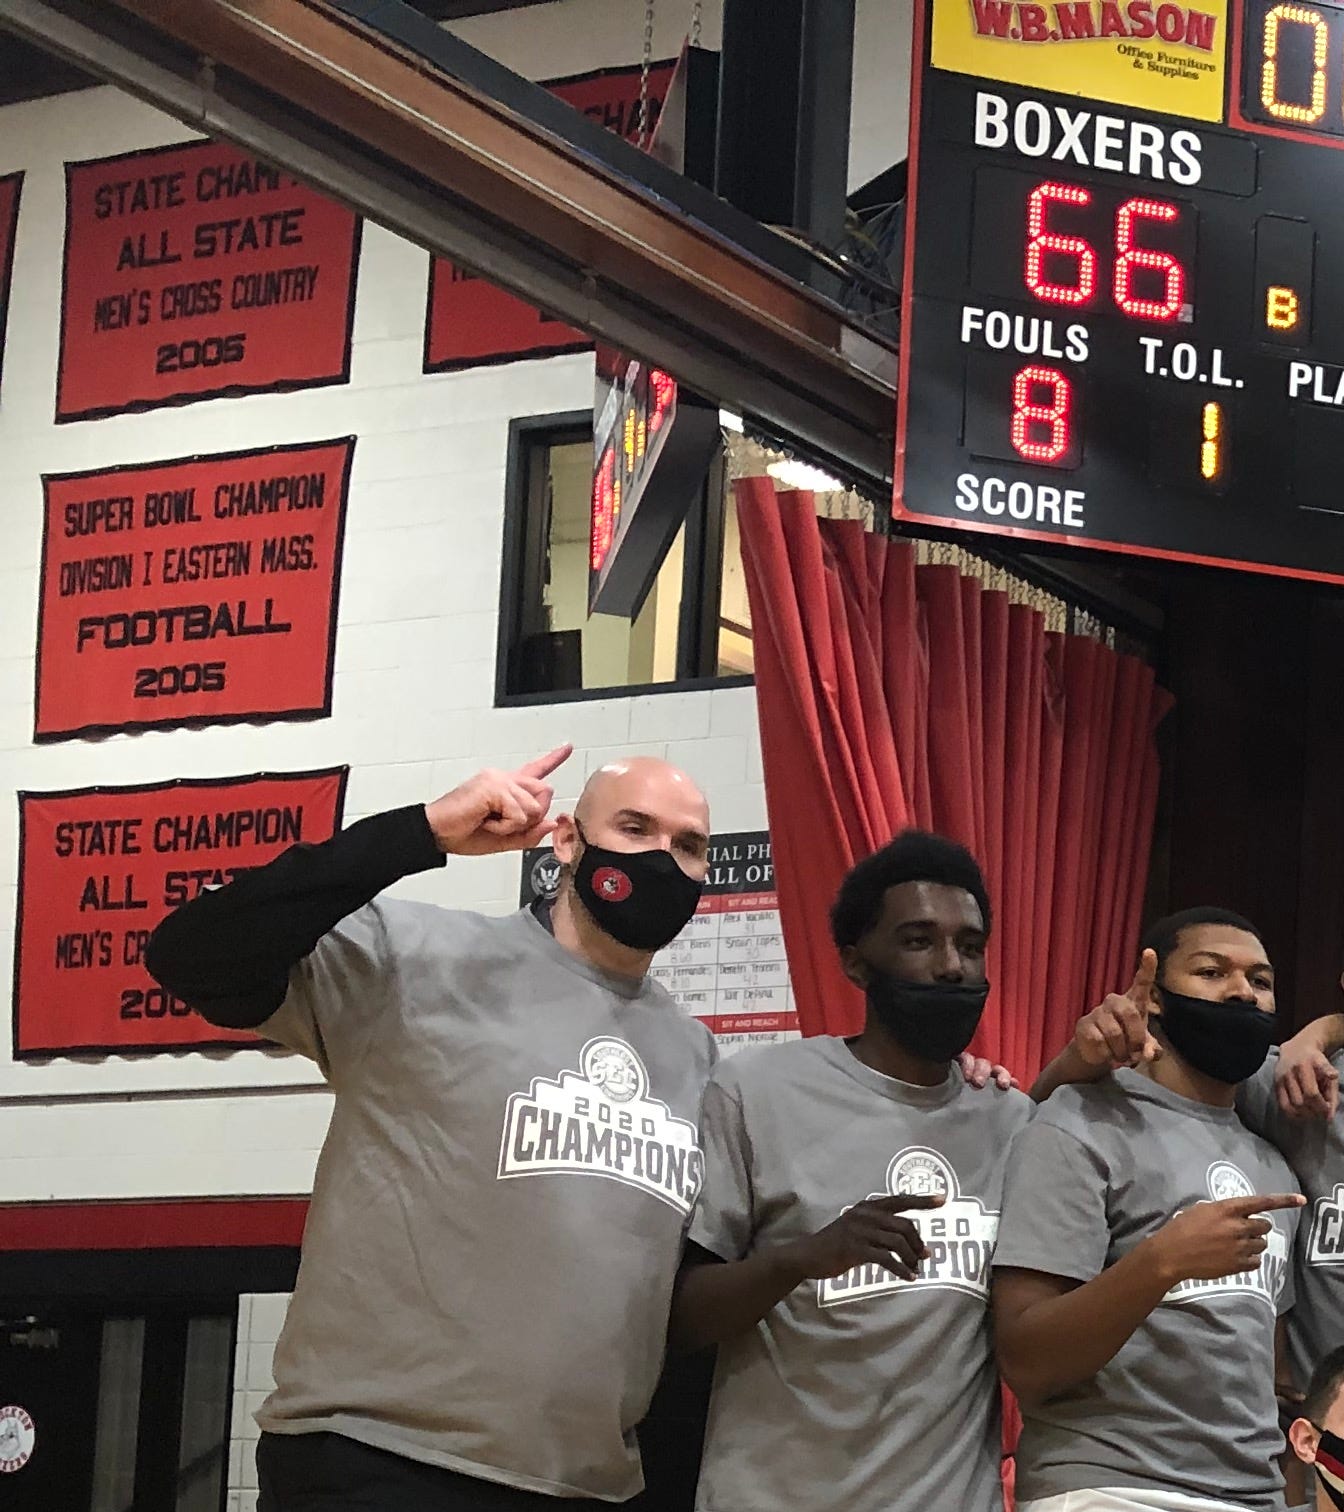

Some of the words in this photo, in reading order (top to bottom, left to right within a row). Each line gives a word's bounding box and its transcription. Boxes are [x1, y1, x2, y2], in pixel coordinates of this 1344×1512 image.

[972, 0, 1216, 51] W.B.MASON
[1117, 43, 1154, 61] Office
[1157, 51, 1216, 73] Furniture
[1133, 59, 1143, 70] &
[1147, 62, 1199, 80] Supplies
[974, 92, 1202, 186] BOXERS
[95, 172, 185, 219] STATE
[196, 161, 290, 201] CHAM
[117, 230, 182, 271] ALL
[194, 208, 305, 258] STATE
[1025, 180, 1184, 321] 66
[94, 288, 151, 333] MEN'S
[160, 279, 221, 321] CROSS
[232, 265, 319, 310] COUNTRY
[1266, 286, 1298, 330] B
[961, 306, 1089, 362] FOULS
[1140, 337, 1244, 388] T.O.L.
[1011, 365, 1070, 462] 8
[1201, 401, 1220, 478] 1
[65, 496, 133, 537] SUPER
[145, 488, 201, 528] BOWL
[214, 472, 325, 519] CHAMPION
[955, 473, 1085, 528] SCORE
[60, 554, 133, 597] DIVISION
[163, 541, 251, 584] EASTERN
[262, 534, 317, 573] MASS.
[77, 598, 291, 653] FOOTBALL
[134, 662, 226, 698] 2005
[55, 819, 142, 857] STATE
[154, 806, 303, 853] CHAMPION
[80, 874, 147, 912] ALL
[55, 930, 112, 968] MEN'S
[120, 988, 192, 1020] 200
[574, 1096, 656, 1137] 2020
[512, 1104, 701, 1201] CHAMPIONS
